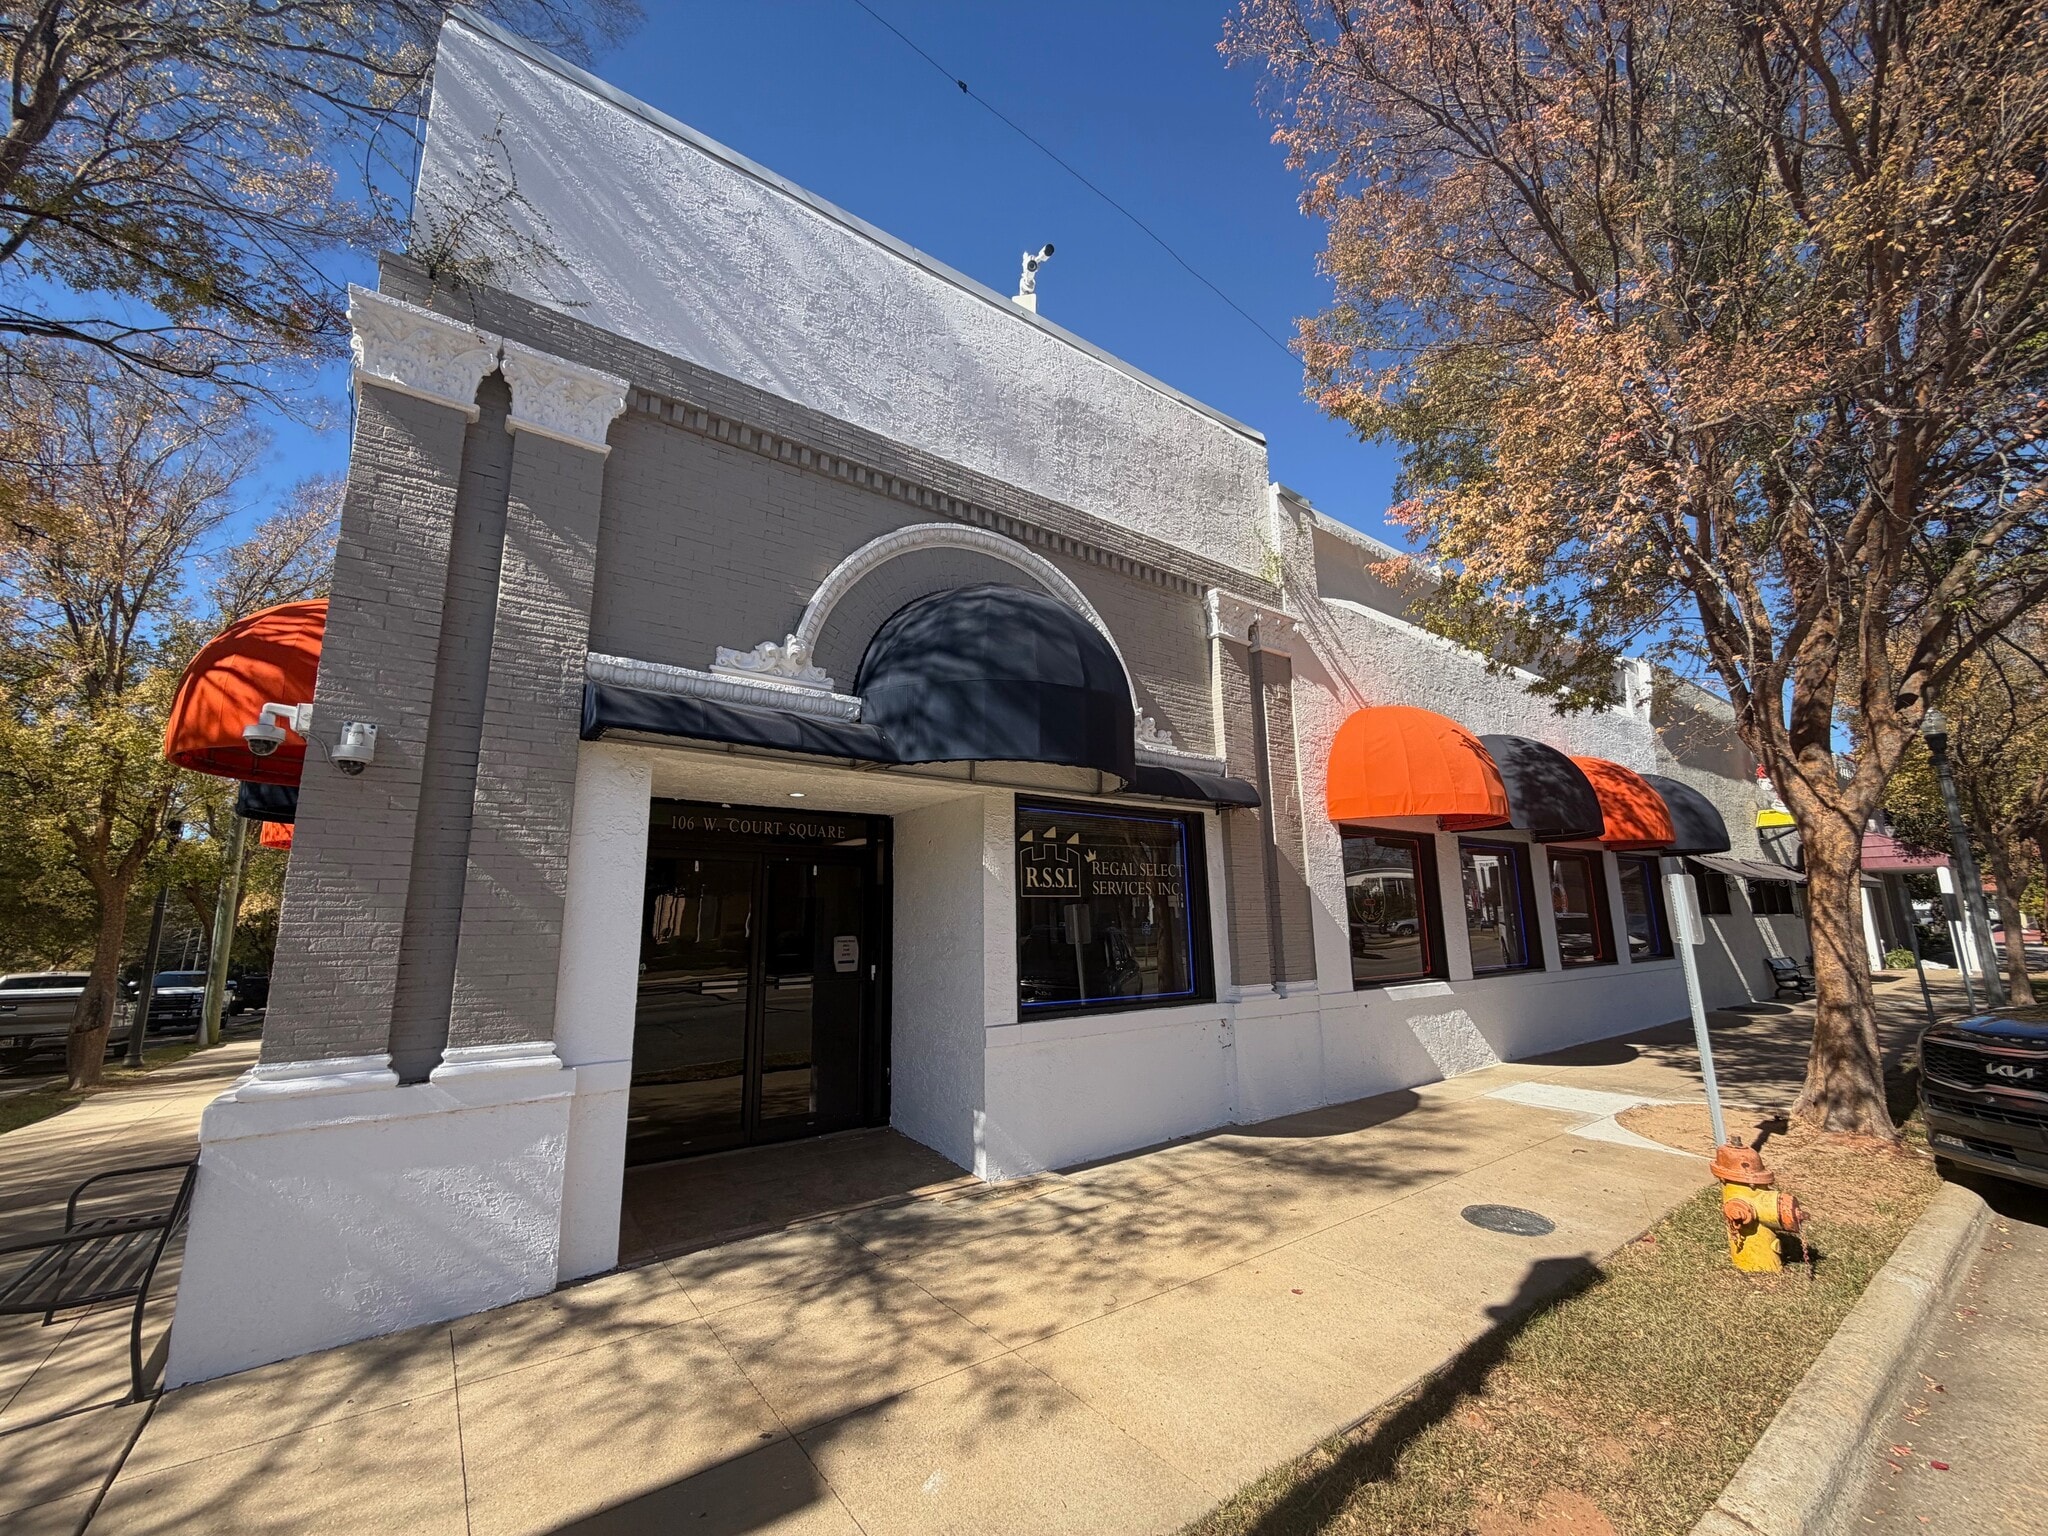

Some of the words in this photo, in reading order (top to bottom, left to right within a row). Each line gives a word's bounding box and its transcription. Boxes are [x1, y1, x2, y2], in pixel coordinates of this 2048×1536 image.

[672, 815, 695, 830] 106
[703, 817, 721, 832] W.
[729, 819, 782, 835] COURT
[788, 821, 846, 839] SQUARE
[1025, 867, 1077, 889] R.S.S.I.
[1092, 861, 1137, 876] REGAL
[1139, 863, 1184, 878] SELECT
[1986, 1062, 2034, 1079] KIA
